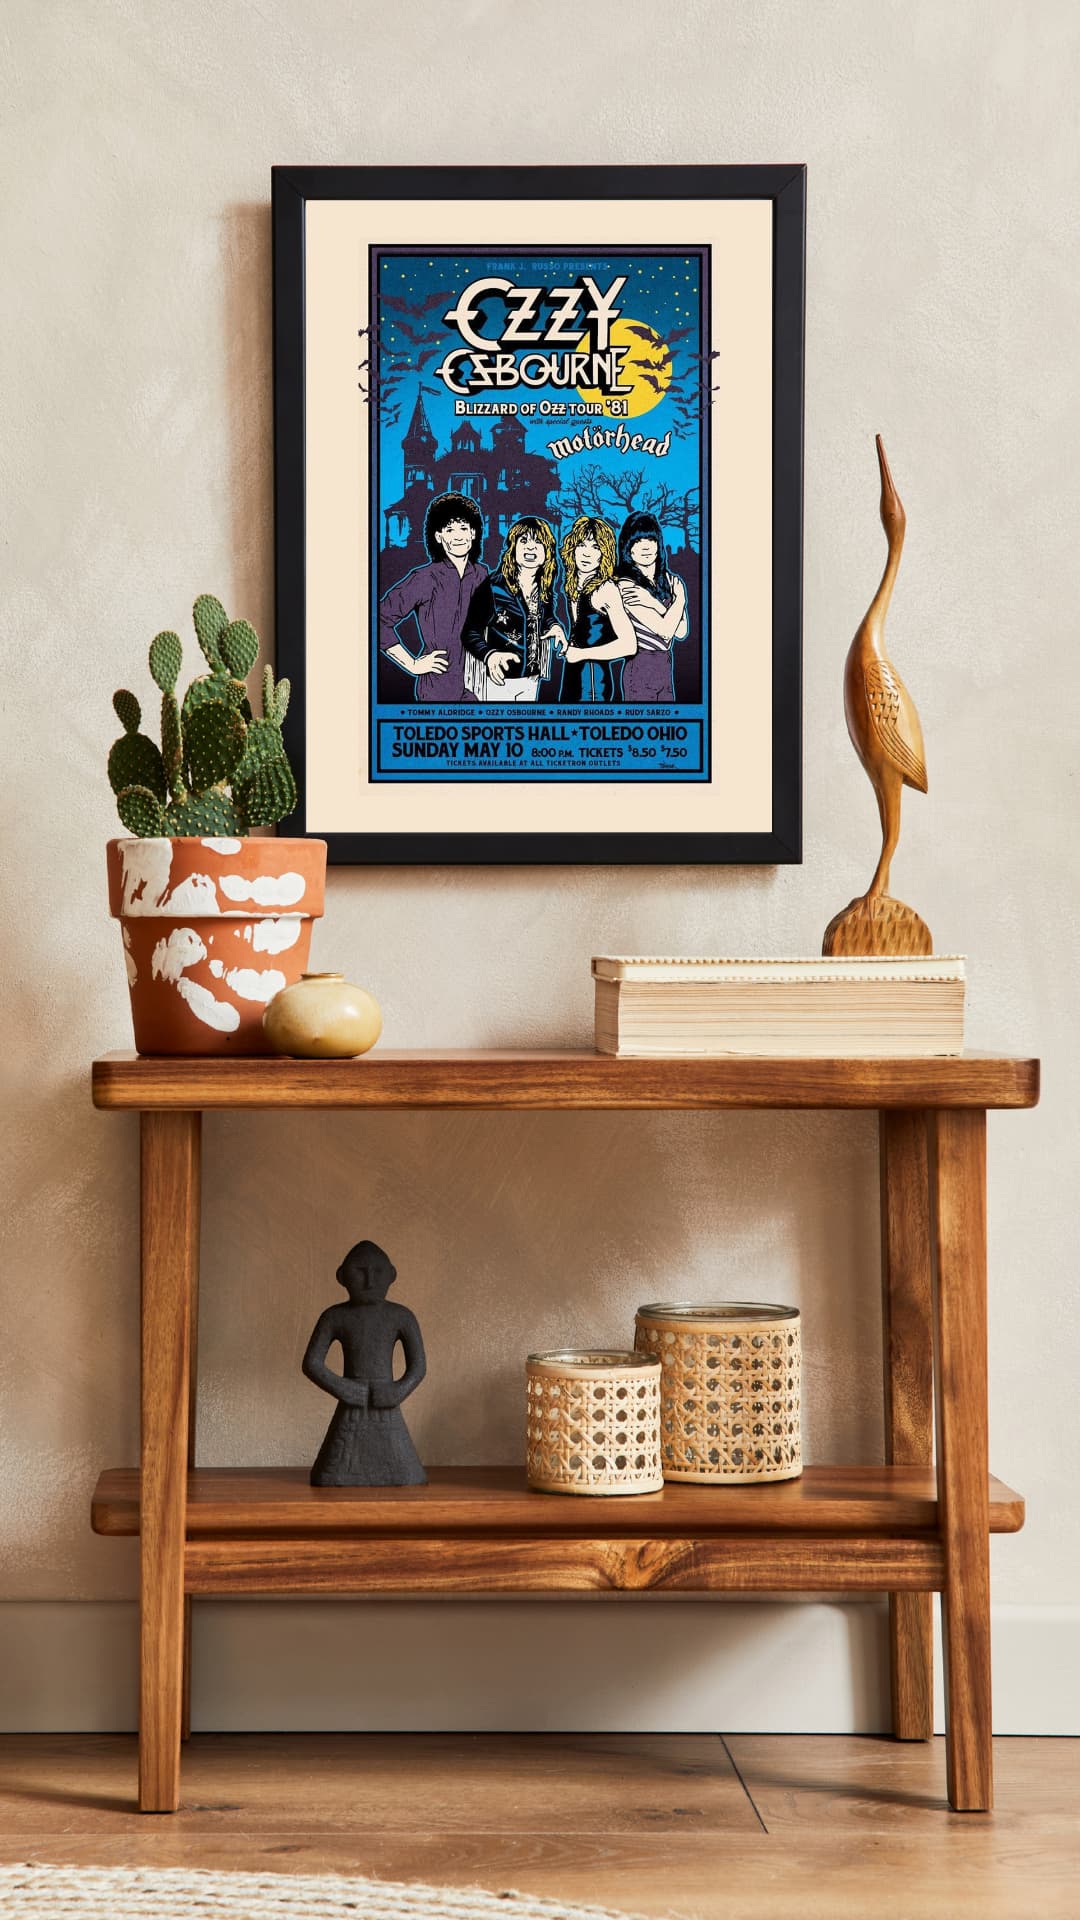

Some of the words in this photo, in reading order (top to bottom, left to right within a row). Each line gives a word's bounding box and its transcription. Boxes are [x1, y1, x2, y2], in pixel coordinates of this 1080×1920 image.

[486, 262, 515, 271] FRANK
[531, 262, 561, 271] RUSSO
[563, 262, 608, 271] PRESENTS
[443, 275, 628, 352] OZZY
[434, 347, 635, 395] OSBOURNE
[455, 399, 518, 416] BLIZZARD
[520, 402, 537, 416] OF
[569, 402, 603, 416] TOUR
[392, 726, 458, 741] TOLEDO
[461, 726, 525, 741] SPORTS
[528, 726, 570, 741] HALL
[579, 726, 644, 741] TOLEDO
[647, 726, 688, 741] OHIO
[392, 742, 459, 758] SUNDAY
[463, 742, 501, 758] MAY
[506, 742, 524, 758] 10
[531, 747, 556, 758] 8:00
[579, 747, 624, 758] TICKETS
[628, 744, 657, 758] $8.50
